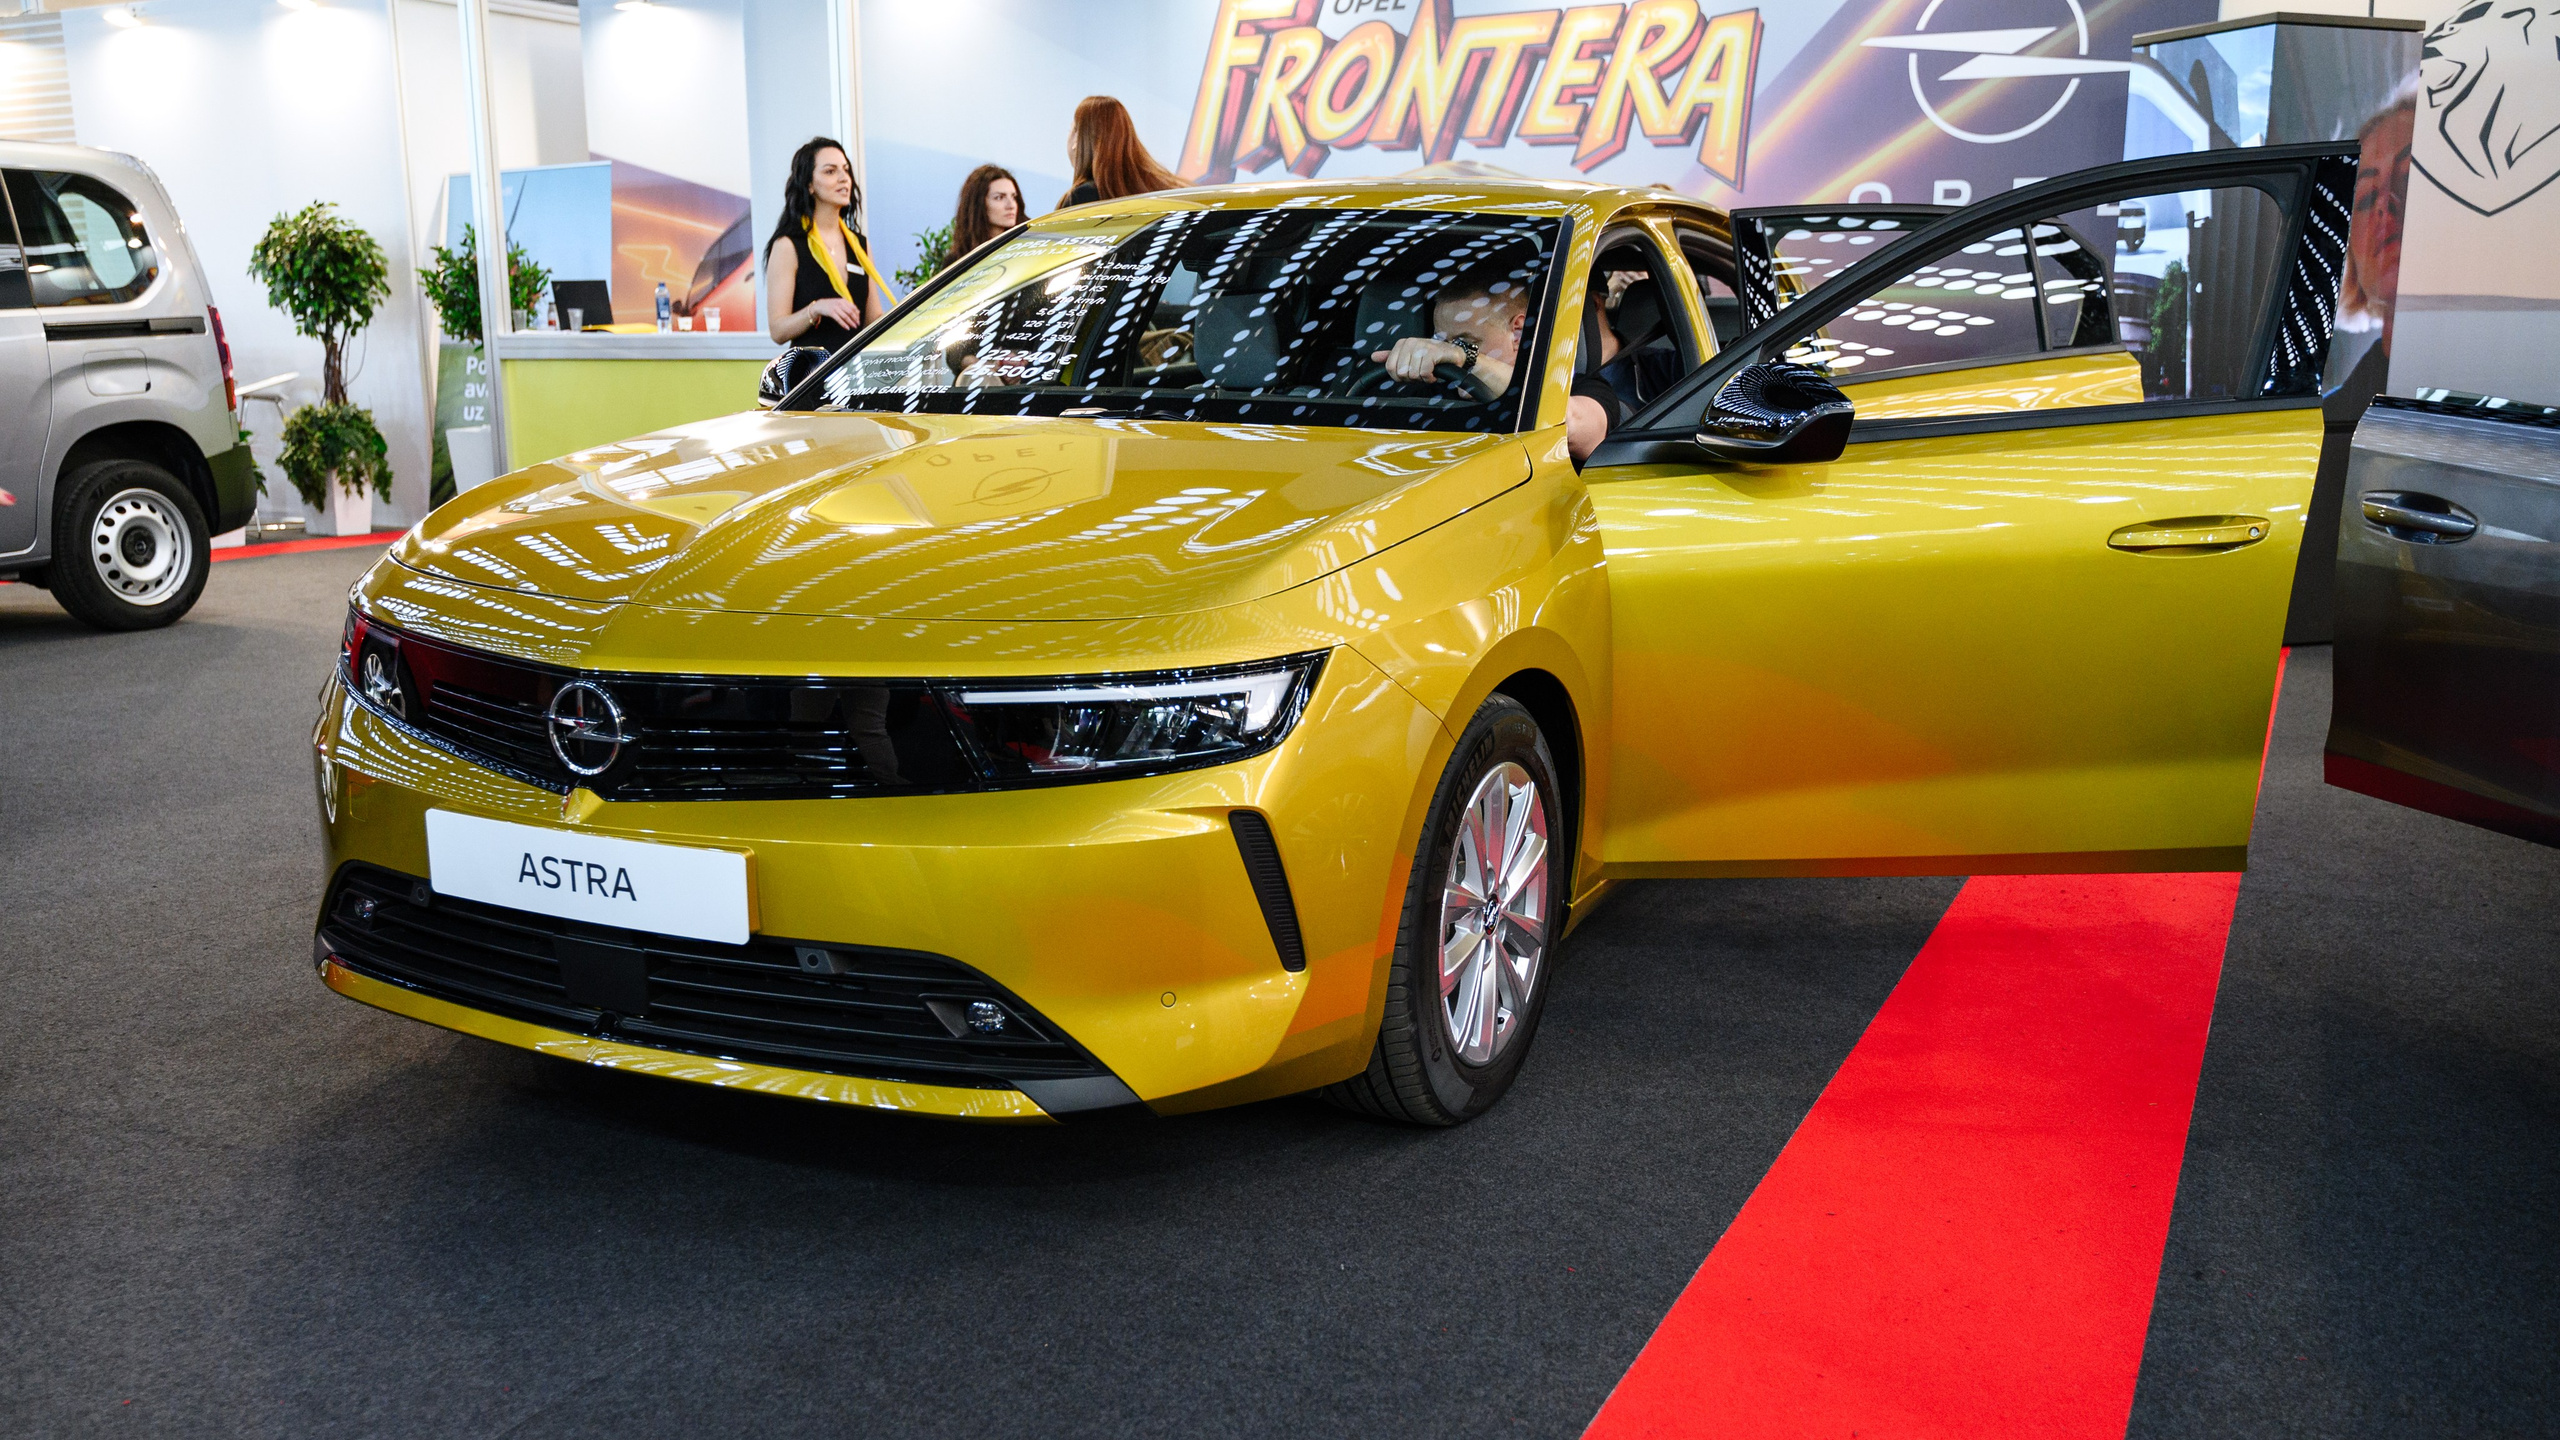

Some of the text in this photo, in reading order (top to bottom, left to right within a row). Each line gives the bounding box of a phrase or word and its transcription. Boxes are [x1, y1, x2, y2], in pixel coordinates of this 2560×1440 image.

[1178, 0, 1765, 191] FRONTERA
[1006, 235, 1119, 251] OPEL ASTRA
[1112, 261, 1155, 272] benzin
[1079, 274, 1172, 285] automatski (8)
[1088, 284, 1108, 293] KS
[1072, 296, 1107, 305] km/h
[1022, 320, 1043, 328] 126
[1006, 332, 1030, 341] 422
[922, 352, 942, 362] od
[981, 350, 1078, 365] 22.240 €
[1041, 368, 1061, 381] €
[463, 405, 485, 421] uz
[518, 852, 638, 902] ASTRA
